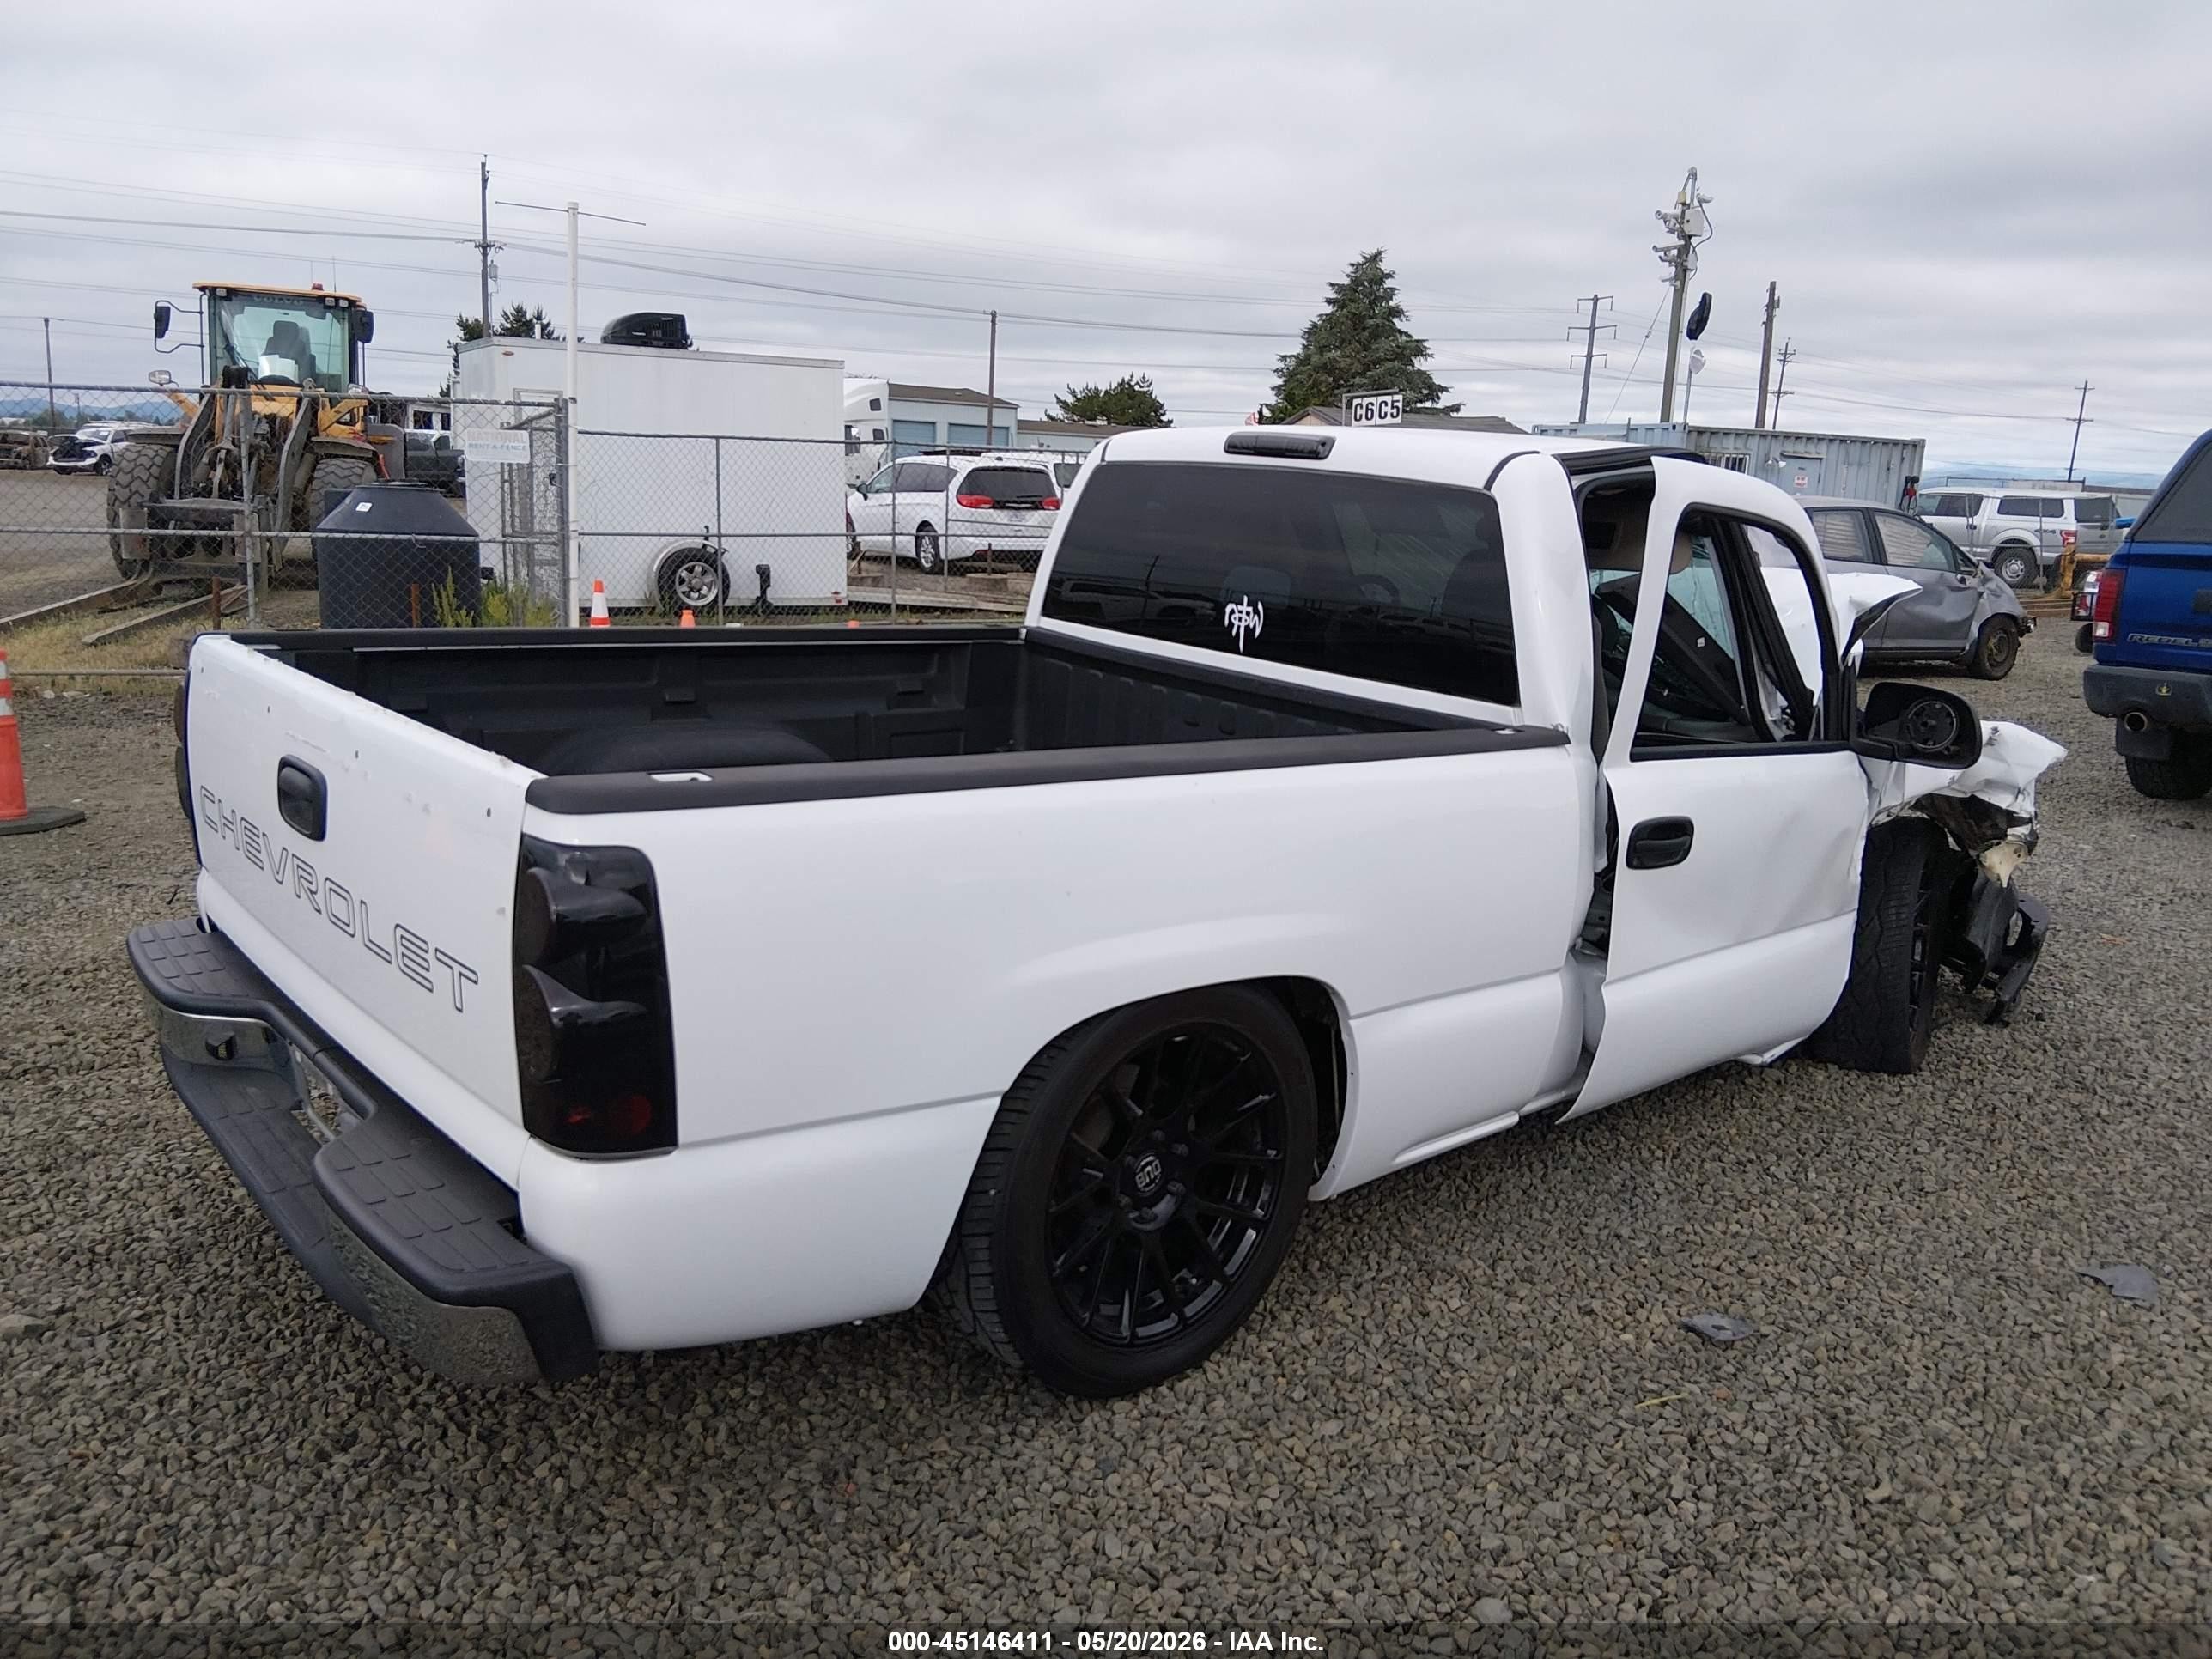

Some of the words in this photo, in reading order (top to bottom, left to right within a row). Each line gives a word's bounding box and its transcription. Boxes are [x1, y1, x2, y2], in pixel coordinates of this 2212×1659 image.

[1353, 402, 1375, 422] C6
[1378, 398, 1401, 419] C5
[201, 785, 478, 1013] CHEVROLET
